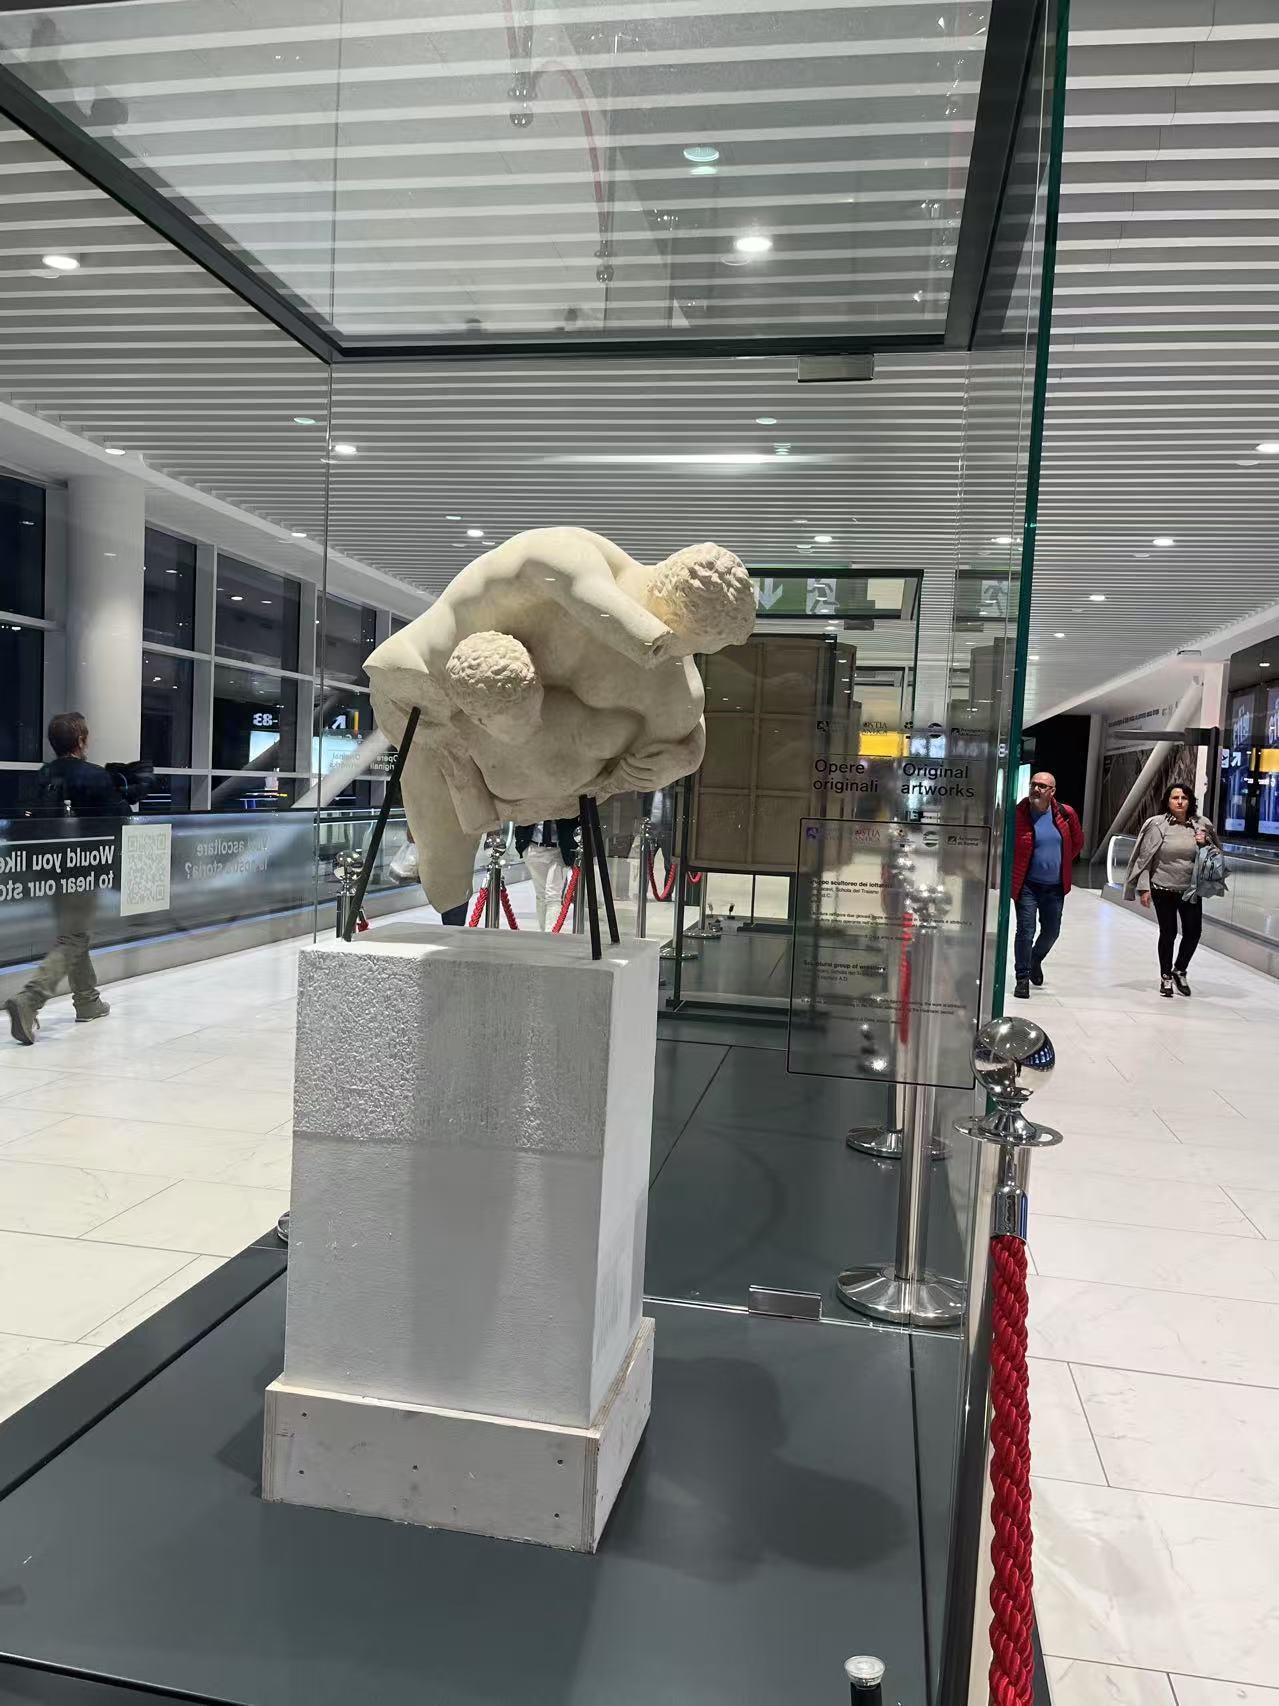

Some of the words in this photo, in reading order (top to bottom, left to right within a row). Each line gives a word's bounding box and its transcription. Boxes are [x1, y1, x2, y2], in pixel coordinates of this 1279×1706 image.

[815, 759, 865, 776] Opere
[902, 763, 968, 781] Original
[813, 778, 878, 794] originali
[901, 782, 975, 798] artworks
